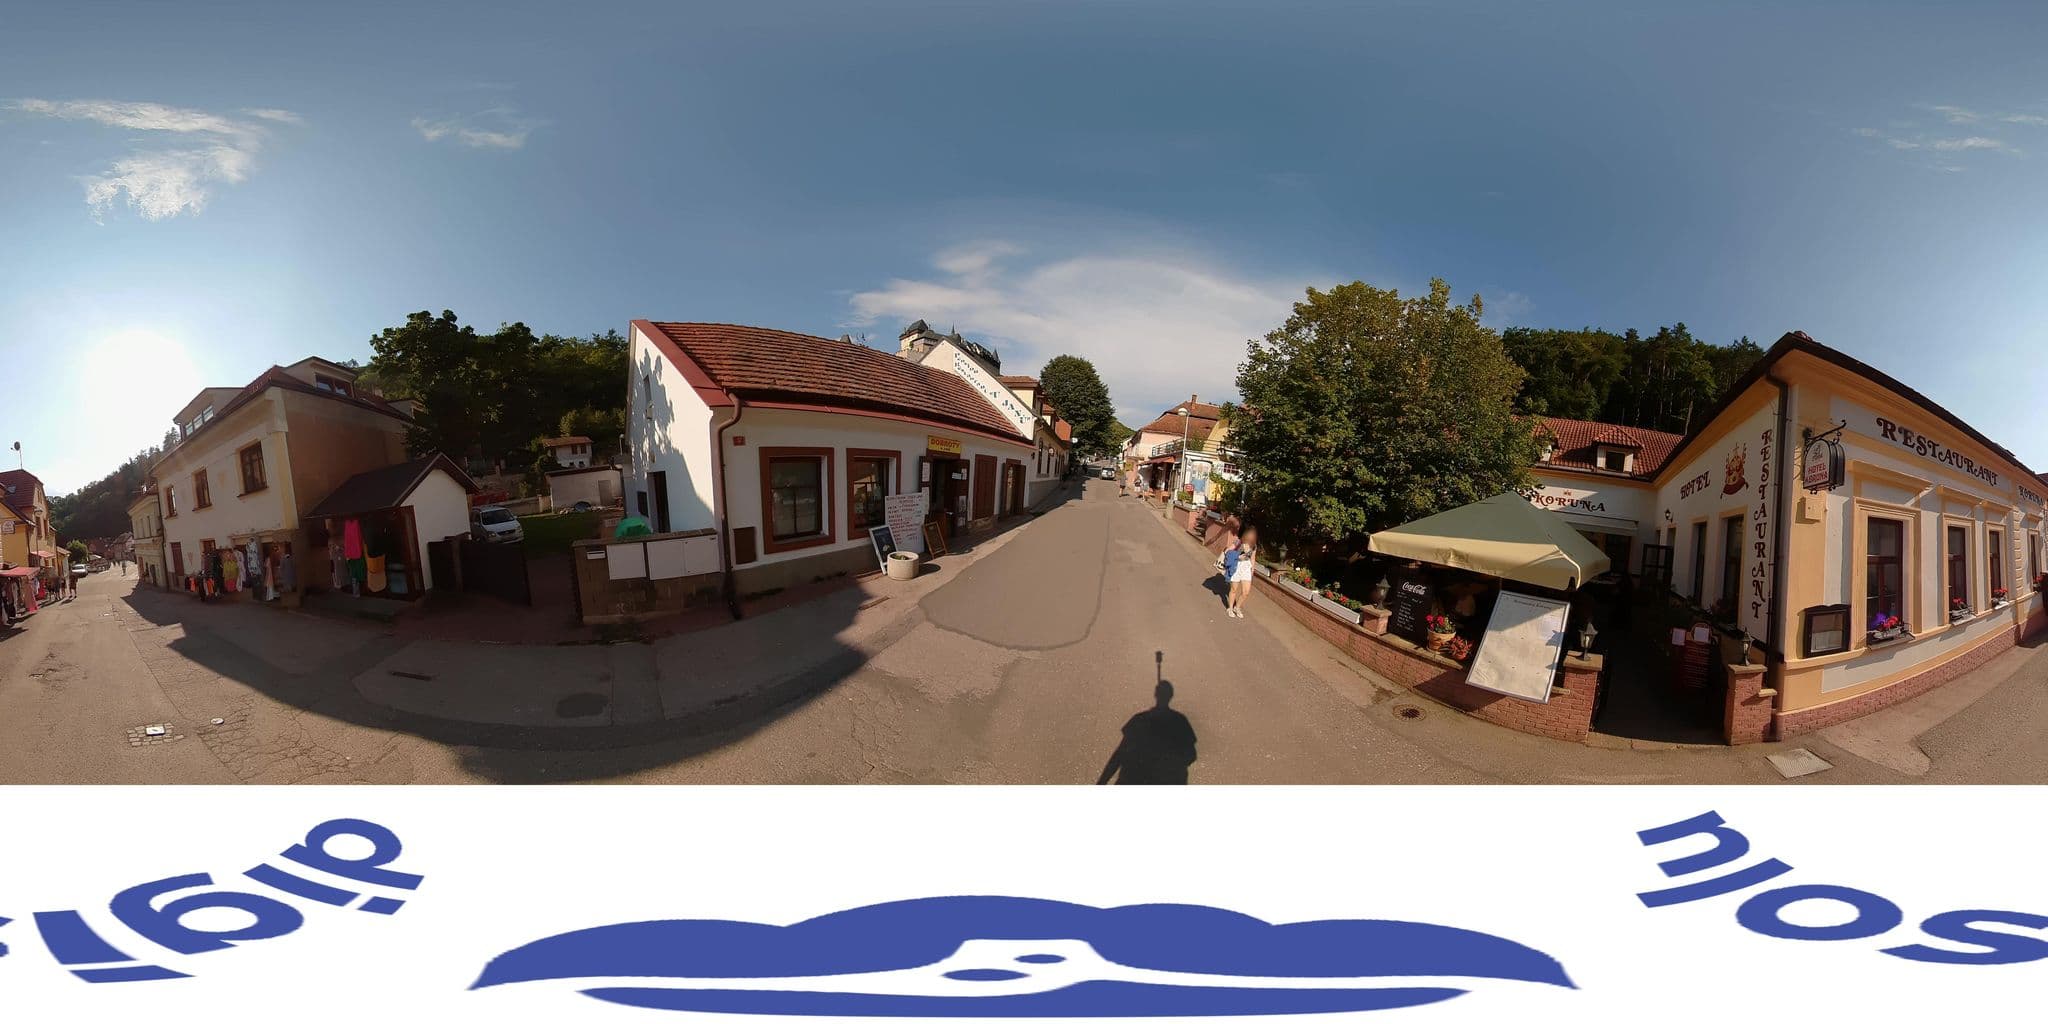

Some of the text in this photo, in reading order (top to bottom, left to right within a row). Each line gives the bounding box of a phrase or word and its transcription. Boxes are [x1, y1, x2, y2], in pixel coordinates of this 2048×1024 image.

[930, 438, 960, 449] DOBROTY
[1876, 417, 1999, 486] RESTAURANT
[1807, 462, 1827, 473] HOTEL
[1680, 471, 1710, 500] HOTEL
[1534, 493, 1606, 512] KORUNA
[1752, 428, 1773, 619] RESTAURANT
